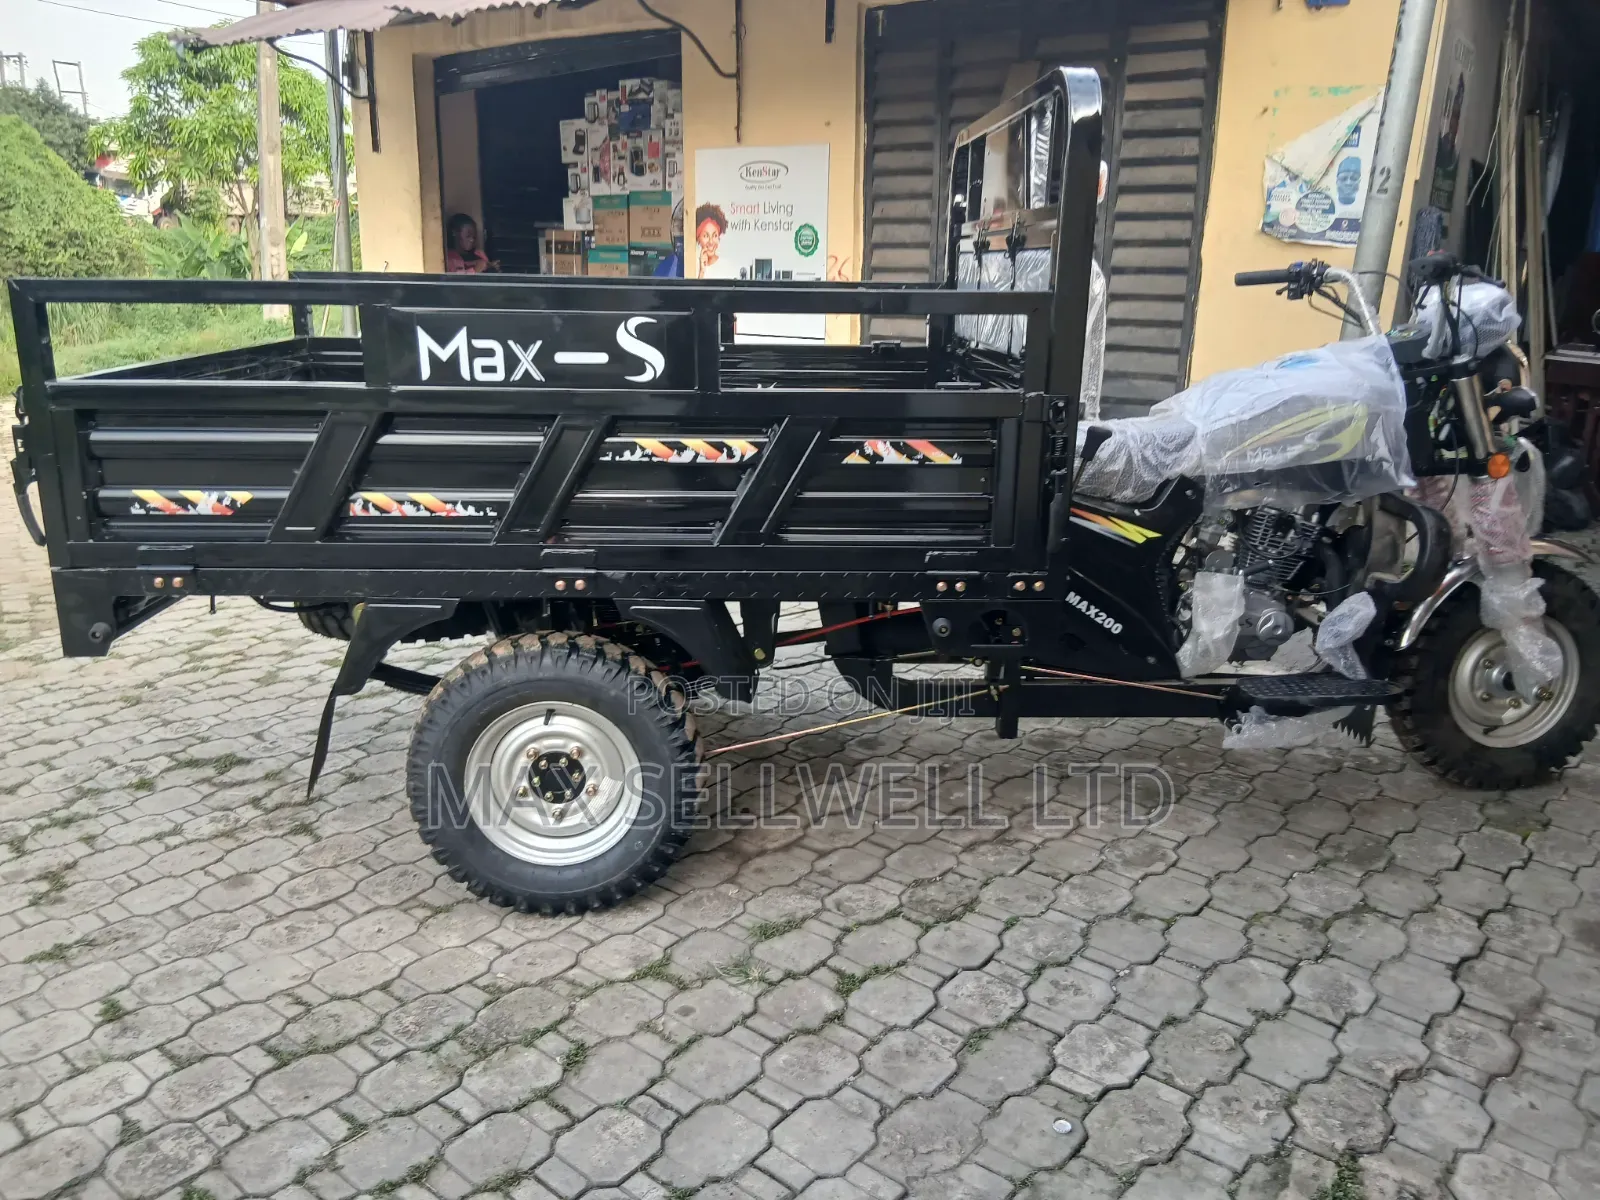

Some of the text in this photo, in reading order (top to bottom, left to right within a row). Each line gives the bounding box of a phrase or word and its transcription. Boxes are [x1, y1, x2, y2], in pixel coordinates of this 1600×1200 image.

[744, 165, 781, 178] KenStar
[730, 200, 794, 217] Smart Living
[730, 218, 794, 231] with Kenstar
[1064, 591, 1123, 635] MAX200
